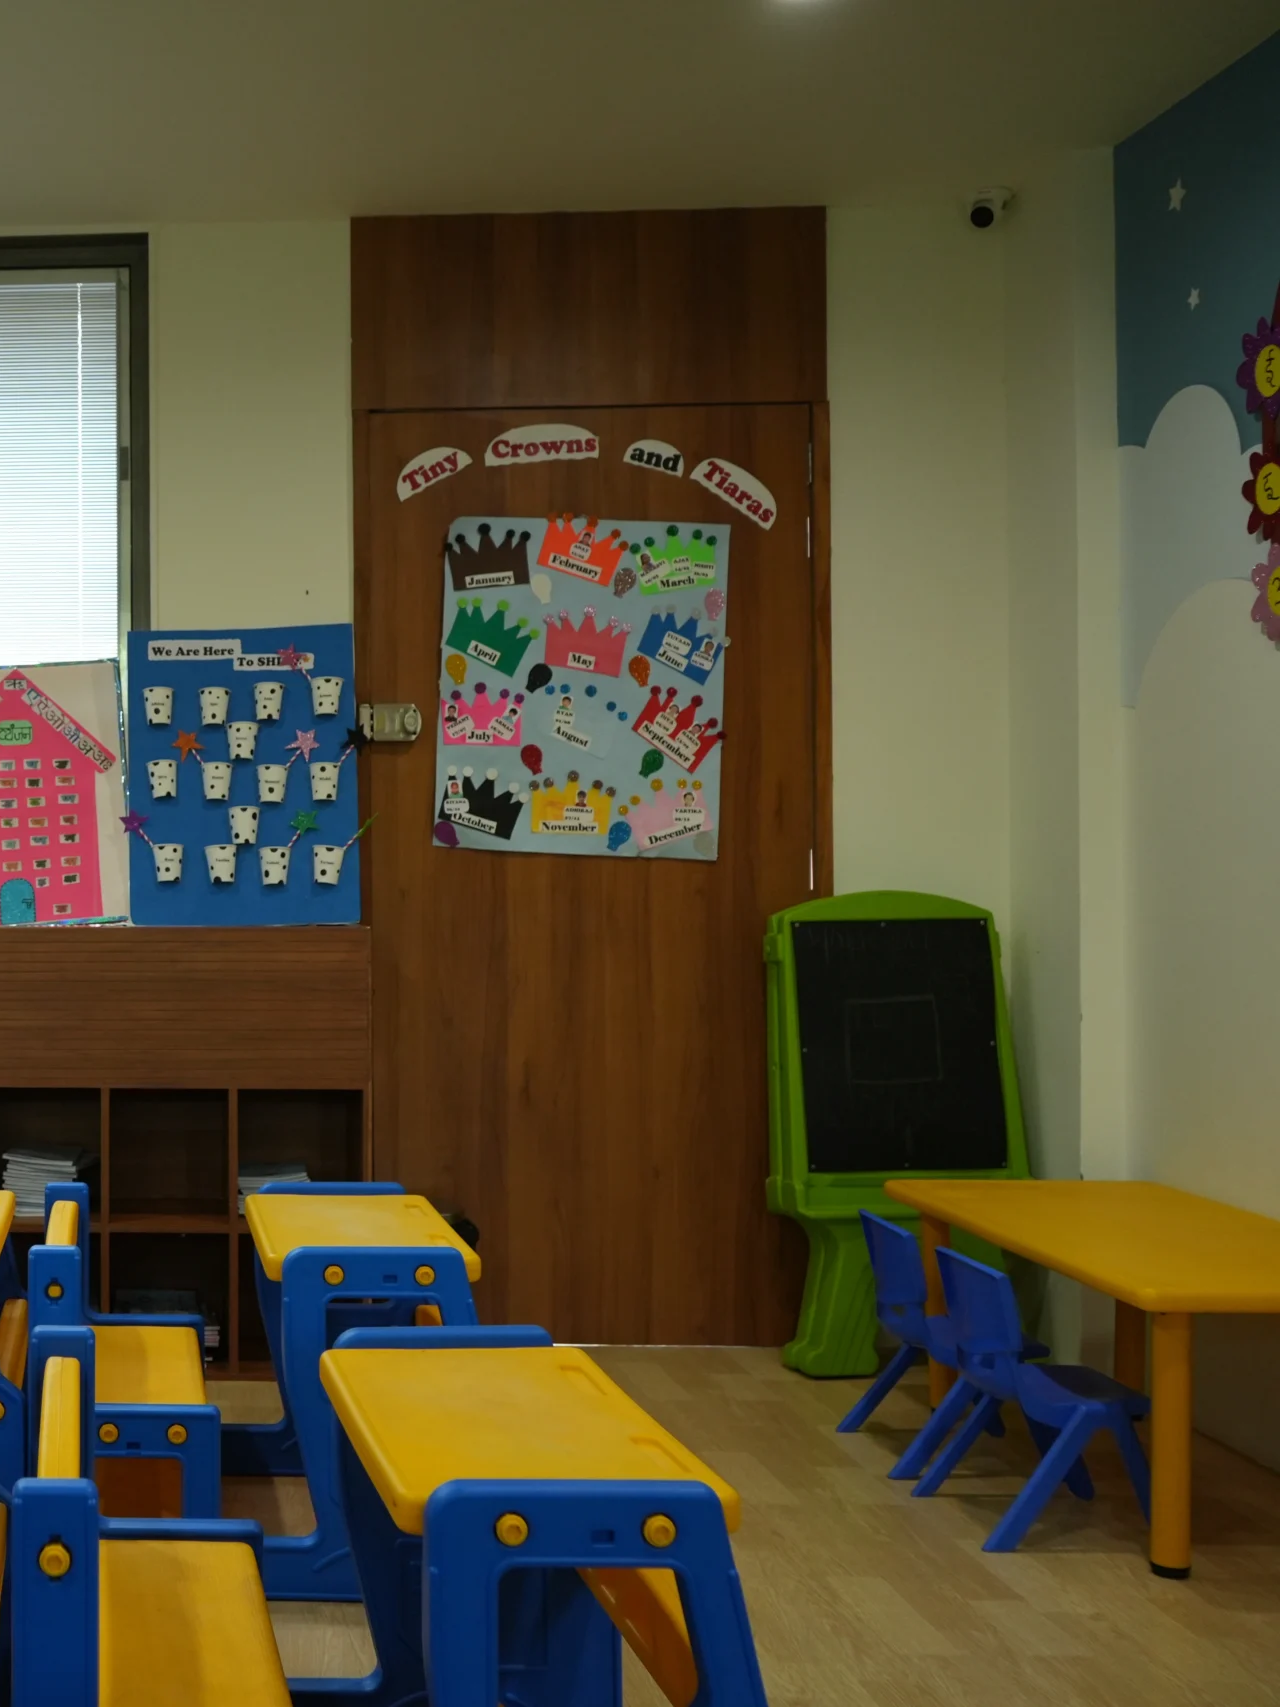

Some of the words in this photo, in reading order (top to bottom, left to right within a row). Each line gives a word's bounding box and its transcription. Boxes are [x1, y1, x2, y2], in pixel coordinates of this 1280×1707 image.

[401, 450, 460, 492] Tiny
[491, 436, 597, 459] Crowns
[630, 445, 681, 473] and
[703, 460, 775, 524] Tiaras
[551, 554, 600, 579] February
[467, 573, 513, 587] January
[660, 576, 696, 589] March
[152, 647, 172, 657] We
[176, 647, 200, 657] Are
[203, 646, 234, 656] Here
[470, 643, 498, 662] April
[571, 653, 594, 667] May
[657, 649, 684, 669] June
[237, 657, 254, 667] To
[467, 731, 493, 743] July
[553, 726, 589, 748] August
[641, 723, 691, 763] September
[453, 812, 495, 832] October
[542, 821, 597, 832] November
[647, 823, 702, 845] December
